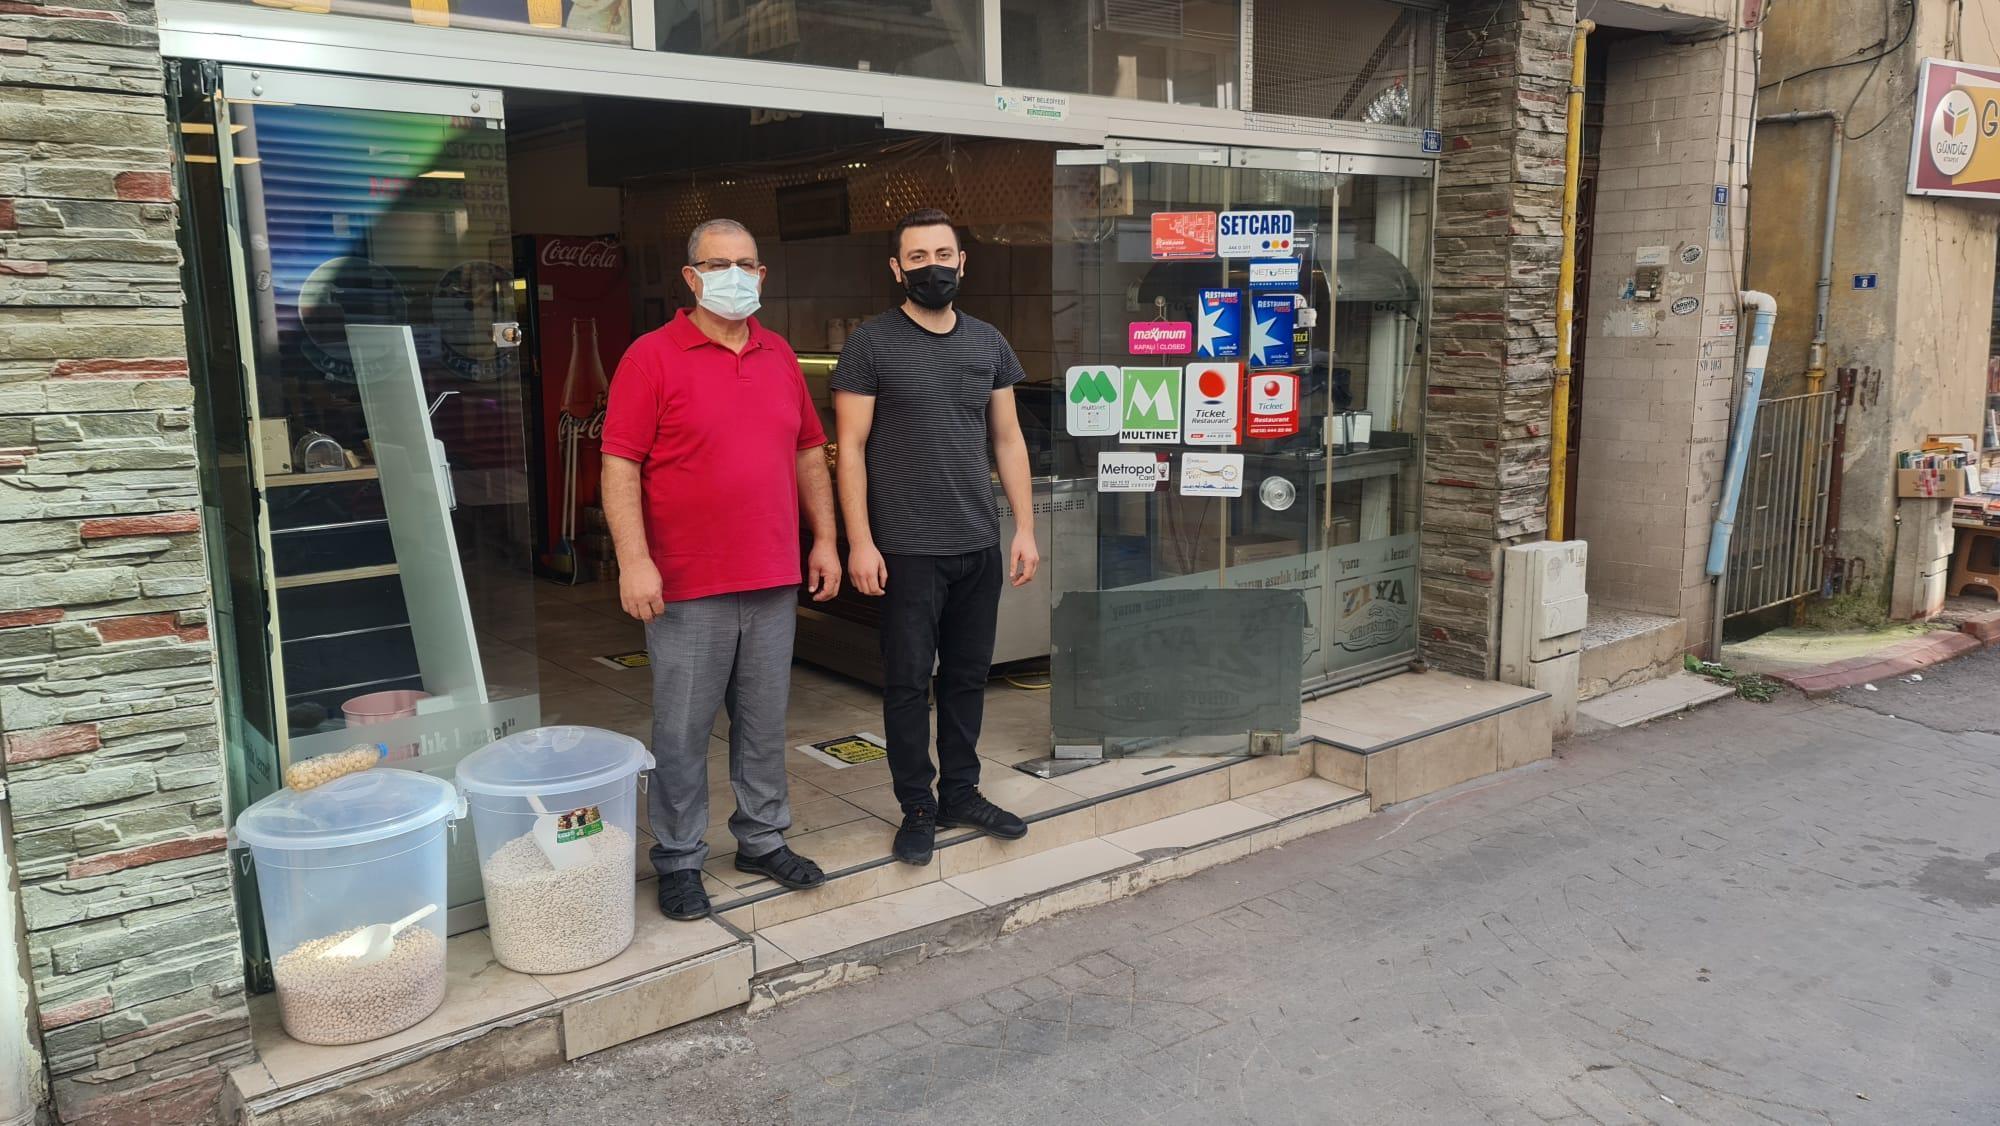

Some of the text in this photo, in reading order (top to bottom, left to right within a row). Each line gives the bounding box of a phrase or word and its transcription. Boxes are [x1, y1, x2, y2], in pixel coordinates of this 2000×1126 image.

[1936, 140, 1969, 156] GÜNDÜZ
[1221, 214, 1292, 235] SETCARD
[541, 239, 617, 268] Coca-Cola
[1134, 327, 1186, 341] maximum
[1259, 402, 1284, 410] Ticket
[1195, 409, 1226, 417] Ticket
[1122, 431, 1178, 440] MULTINET
[1101, 463, 1155, 476] Metropol
